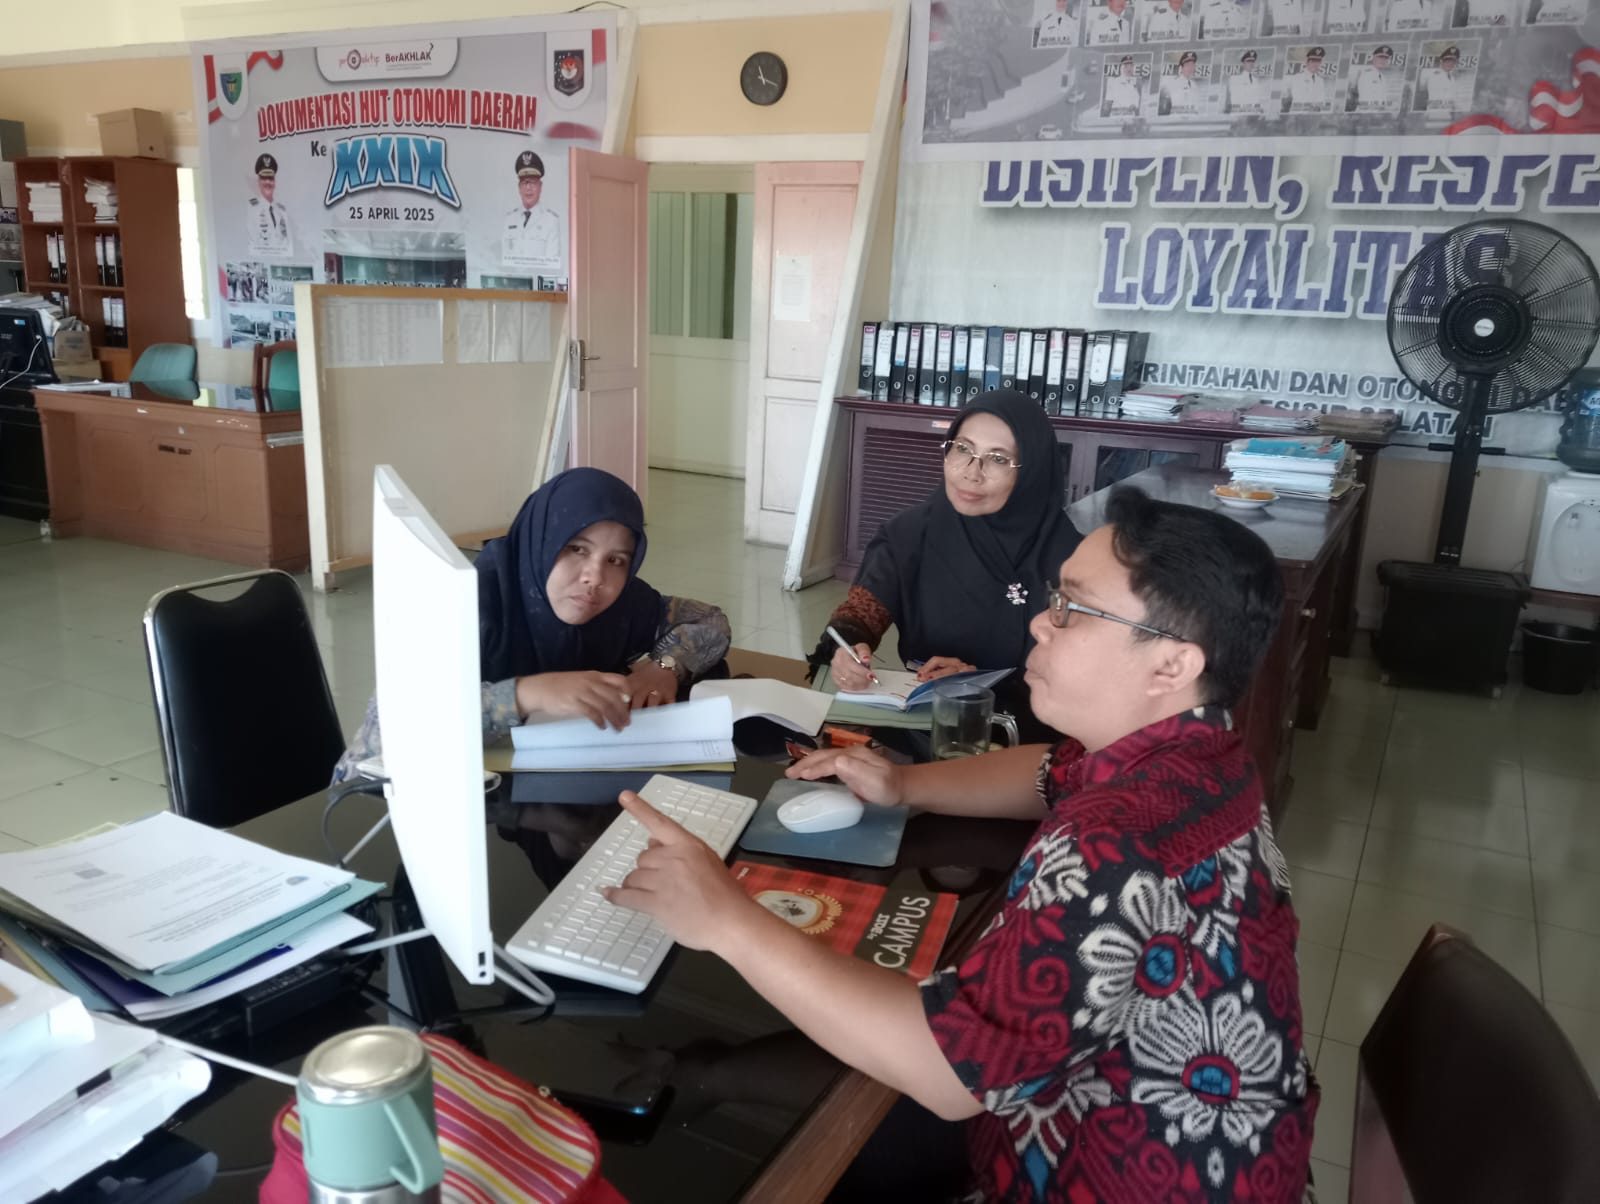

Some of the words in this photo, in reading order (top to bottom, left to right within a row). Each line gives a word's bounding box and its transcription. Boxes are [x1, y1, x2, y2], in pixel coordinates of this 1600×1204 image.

[385, 48, 434, 63] BerAKHLAK
[257, 92, 356, 139] DOKUMENTASI
[360, 89, 390, 125] HUT
[393, 88, 466, 126] OTONOMI
[471, 90, 537, 132] DAERAH
[310, 140, 327, 157] Ke
[328, 135, 459, 205] XXIX
[350, 207, 363, 220] 25
[368, 207, 400, 221] APRIL
[404, 208, 435, 221] 2025
[1290, 371, 1347, 396] DAN
[873, 896, 931, 969] CAMPUS
